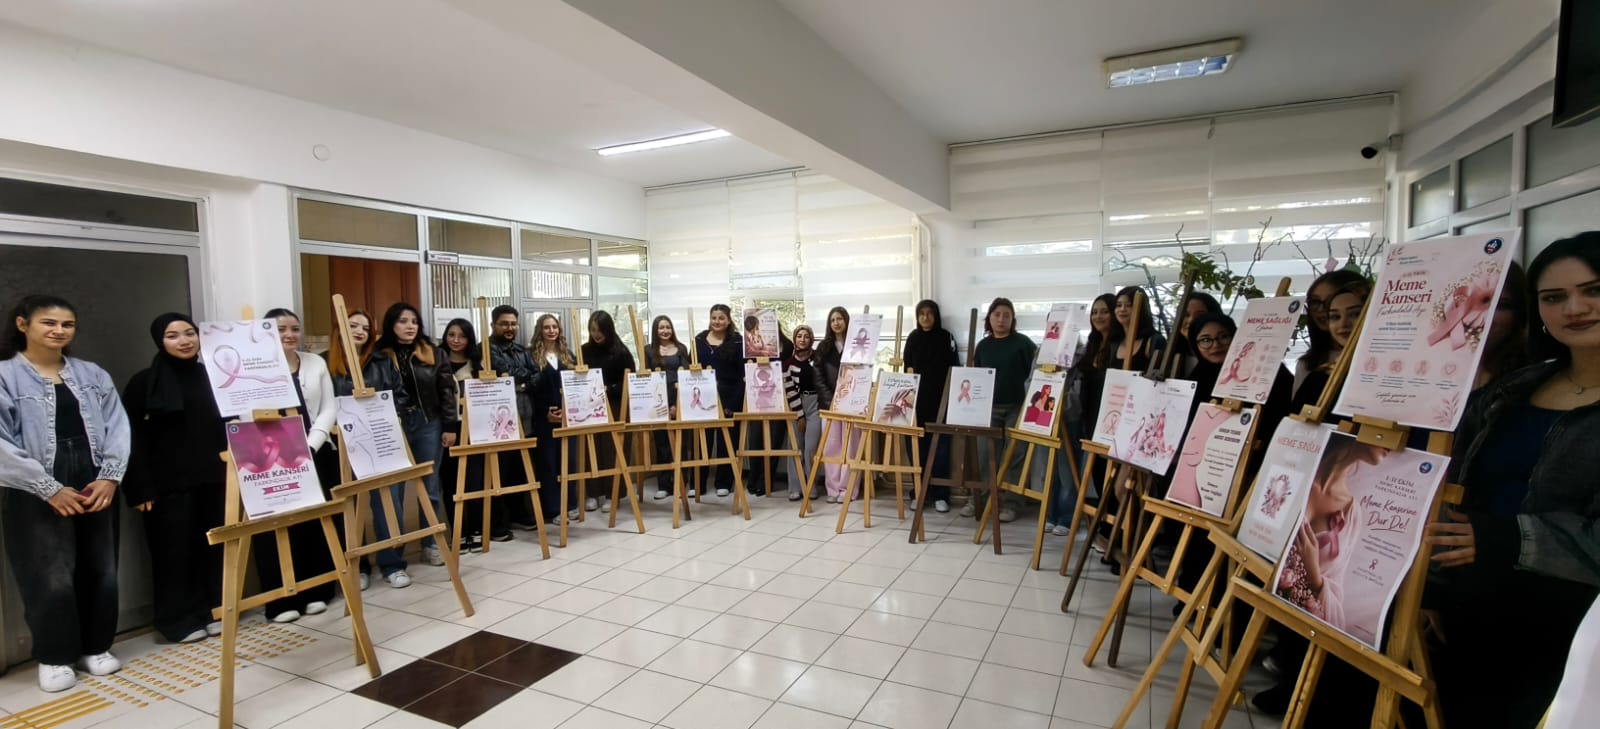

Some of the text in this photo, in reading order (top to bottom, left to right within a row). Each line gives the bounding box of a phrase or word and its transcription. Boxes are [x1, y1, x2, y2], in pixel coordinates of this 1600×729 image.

[1384, 280, 1427, 292] Meme
[1381, 289, 1433, 304] Kanseri
[1277, 436, 1321, 454] MEME SAĞLI
[243, 464, 310, 483] MEME KANSERİ
[1359, 495, 1418, 517] Meme Kanserine
[1367, 511, 1410, 530] Dur De!
